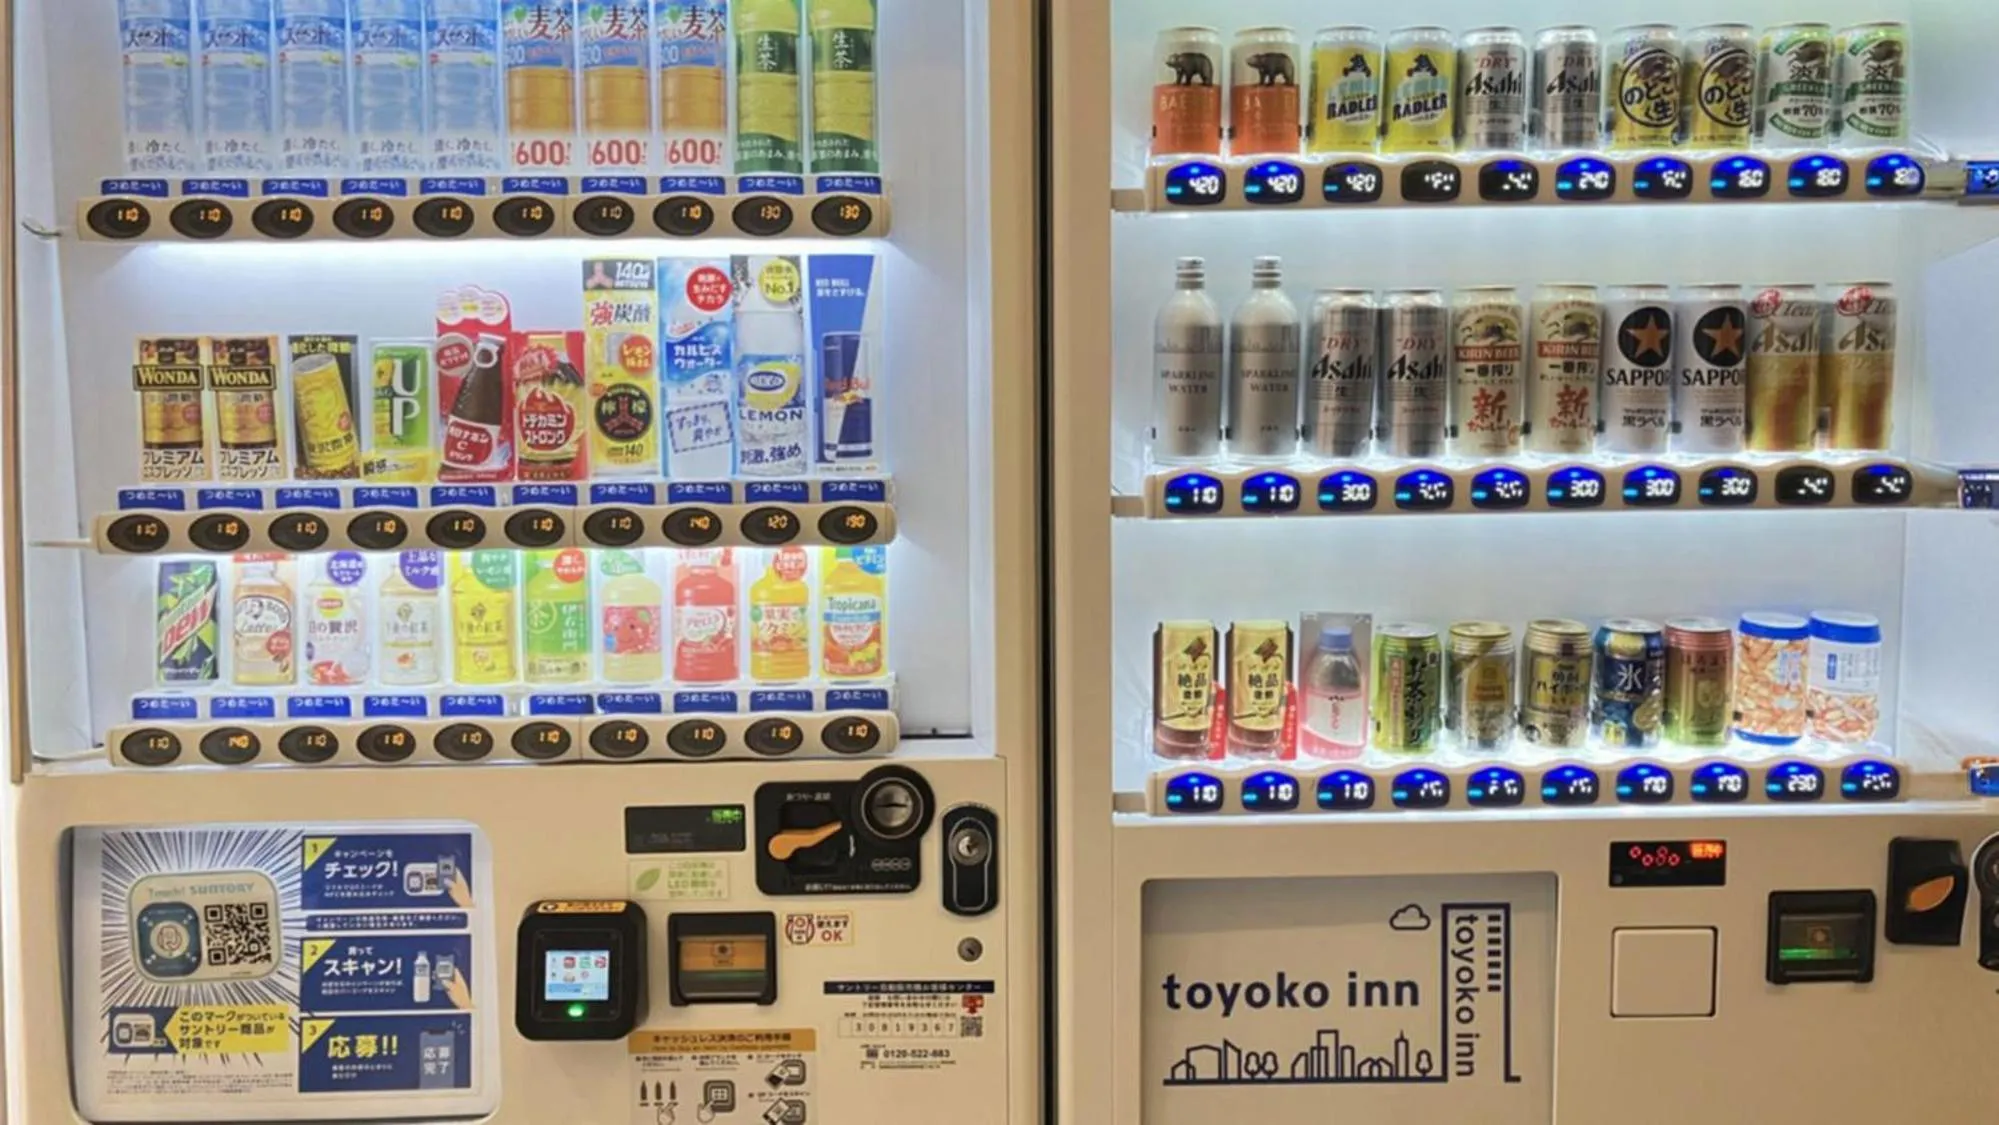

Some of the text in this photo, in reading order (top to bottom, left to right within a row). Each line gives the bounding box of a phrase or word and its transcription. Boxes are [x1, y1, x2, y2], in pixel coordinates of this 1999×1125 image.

[528, 4, 573, 40] 麦茶
[605, 4, 648, 40] 麦茶
[682, 4, 727, 41] 麦茶
[756, 32, 777, 72] 生茶
[831, 28, 853, 69] 生茶
[1465, 71, 1522, 95] Asahi
[1188, 176, 1219, 194] 420
[1267, 176, 1297, 193] 420
[1345, 174, 1375, 193] 420
[764, 280, 794, 294] No.1
[673, 344, 723, 357] カルピス
[1458, 348, 1493, 359] KIRIN
[138, 367, 198, 386] WONDA
[210, 367, 270, 386] WONDA
[1464, 363, 1514, 378] 一番搾り
[1168, 384, 1208, 395] WATER
[1250, 383, 1289, 394] WATER
[1472, 387, 1507, 422] 新
[1556, 384, 1589, 418] 新
[739, 409, 803, 422] LEMON
[1622, 415, 1665, 428] 黒ラベル
[1701, 415, 1742, 428] 黒ラベル
[456, 440, 469, 451] C
[525, 430, 566, 444] ストロング
[143, 450, 203, 464] プレミアム
[219, 450, 279, 464] プレミアム
[1193, 486, 1217, 504] 110
[1269, 485, 1294, 503] 110
[1341, 484, 1371, 501] 300
[1570, 479, 1599, 497] 300
[1645, 478, 1674, 496] 300
[1721, 477, 1750, 495] 300
[827, 596, 877, 611] Tropicana
[1193, 785, 1218, 802] 110
[1268, 784, 1292, 801] 110
[1343, 783, 1368, 799] 110
[324, 860, 398, 879] チェック!
[821, 930, 843, 942] OK
[323, 957, 402, 977] スキャン!
[1162, 971, 1420, 1018] toyoko inn
[1451, 913, 1481, 1077] toyoko inn
[327, 1034, 398, 1059] 応募!!
[424, 1061, 450, 1075] 完了
